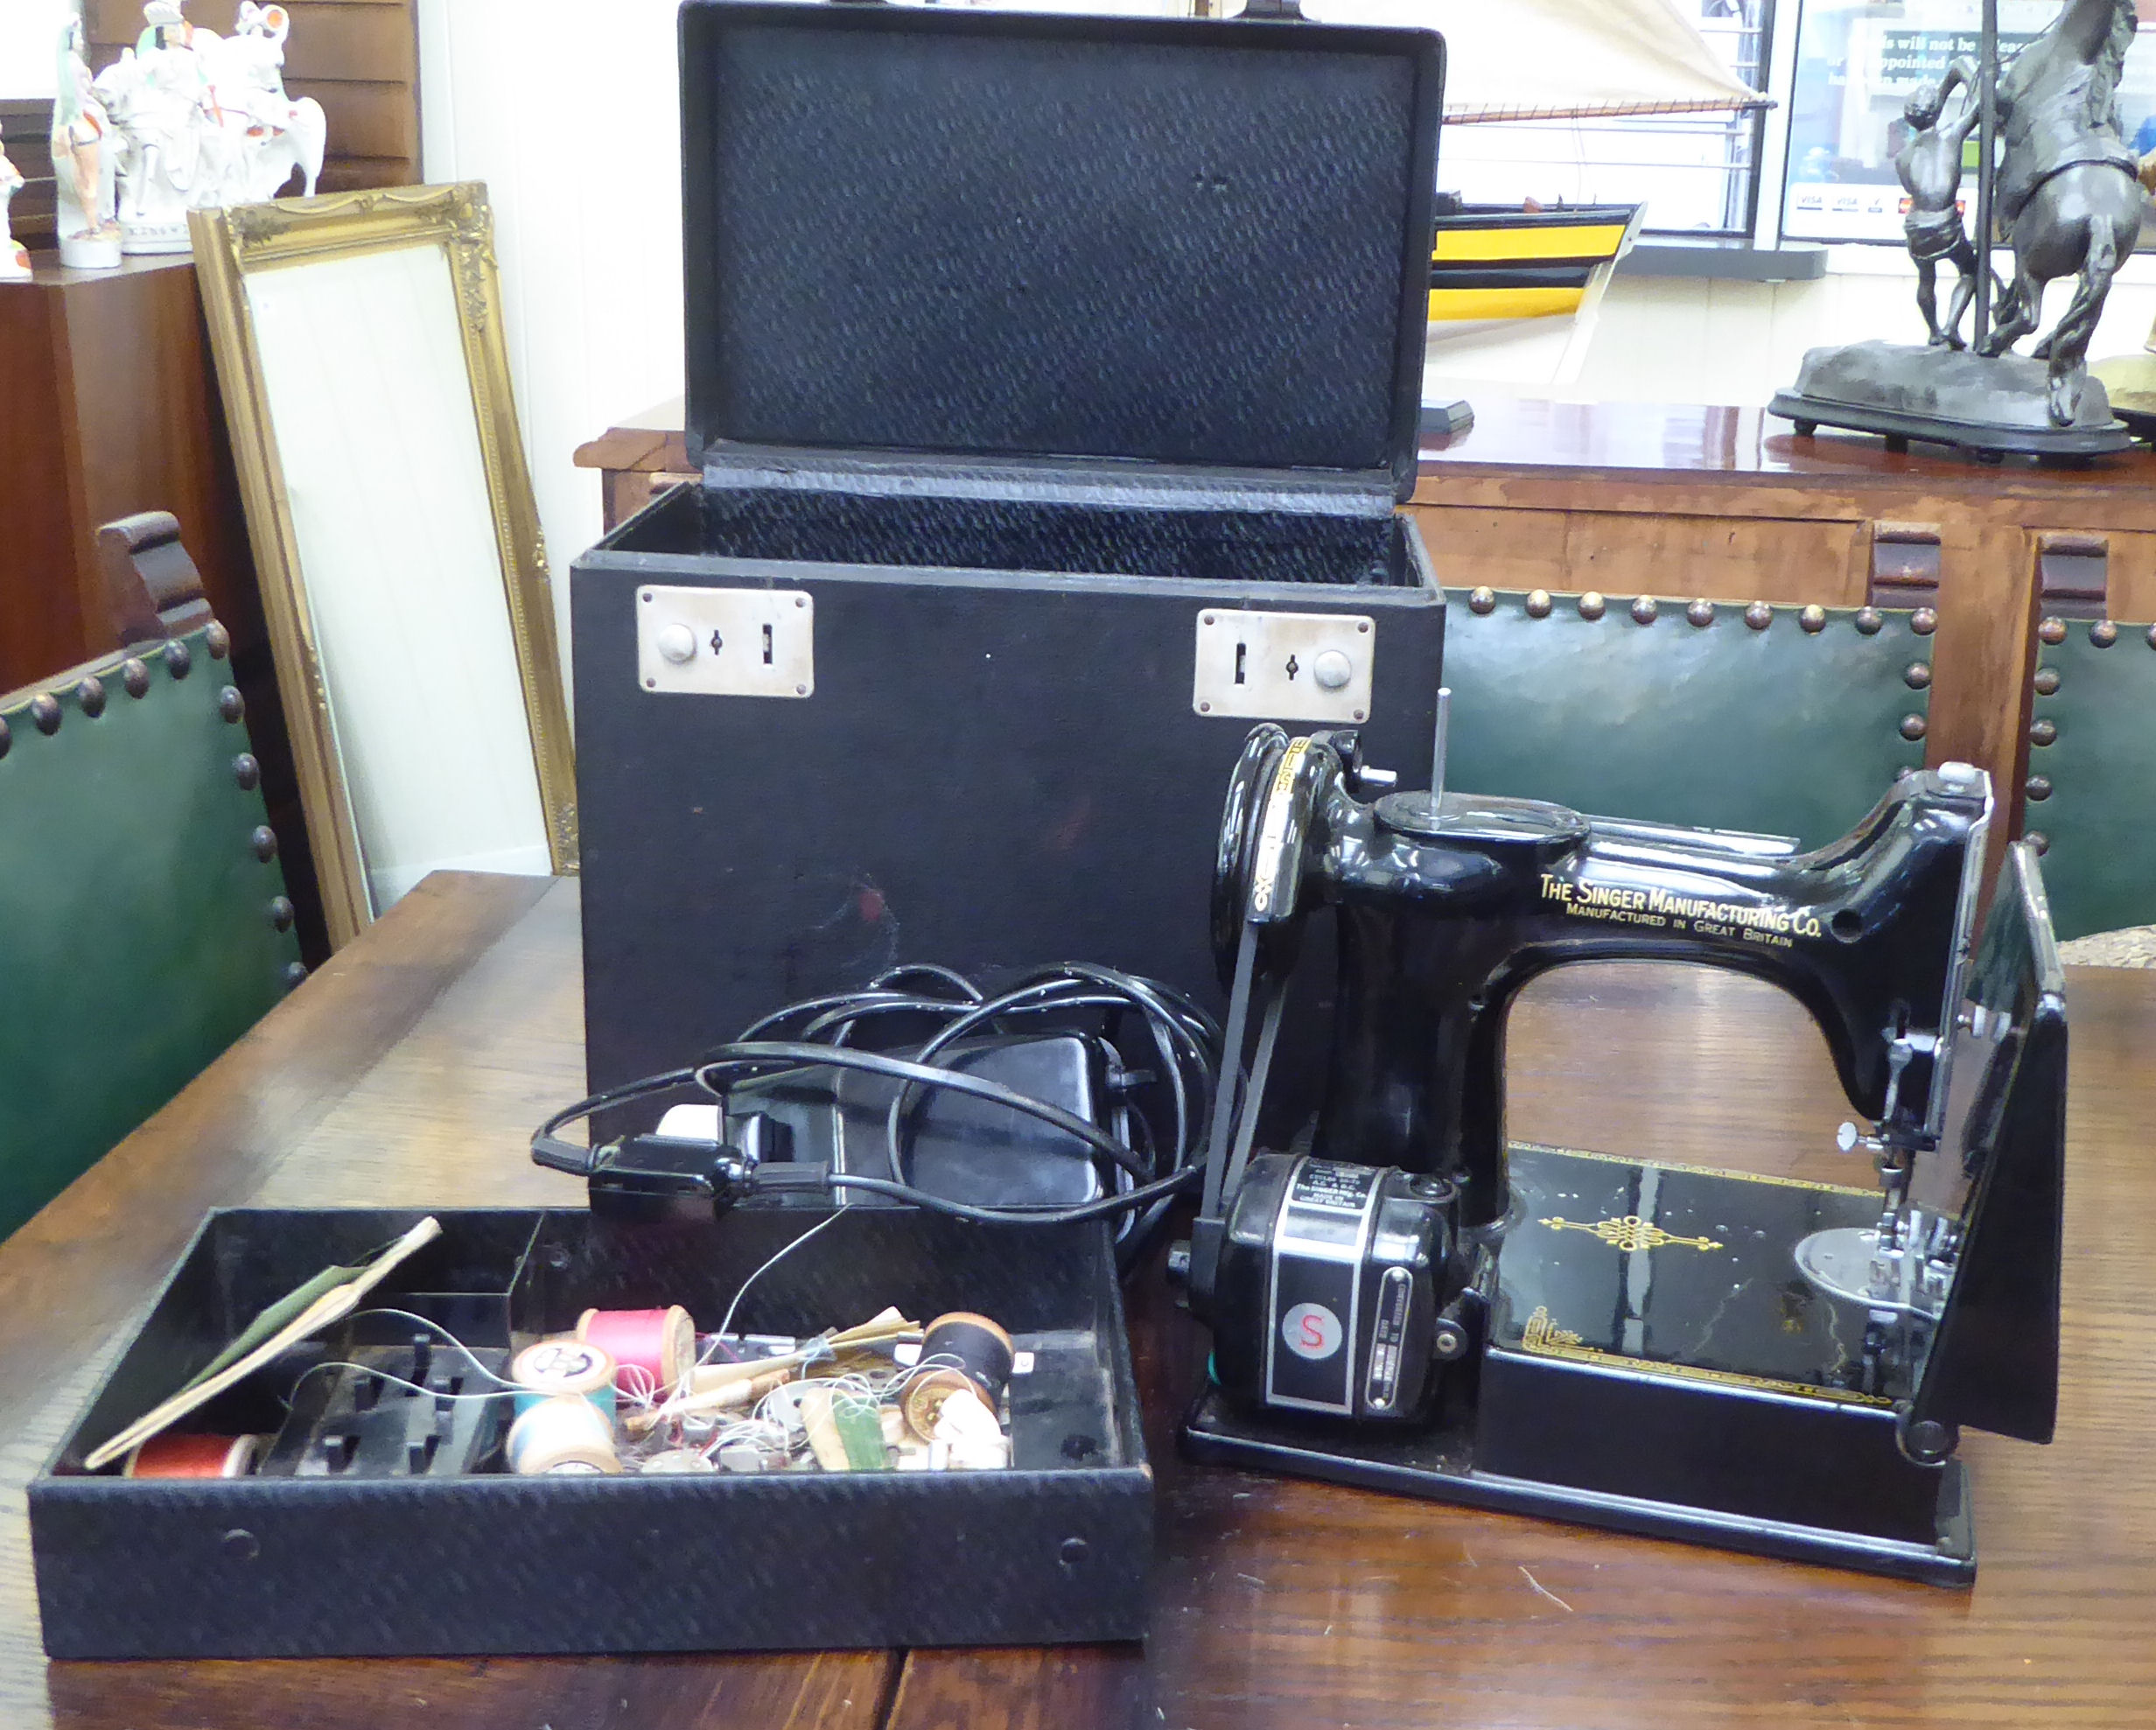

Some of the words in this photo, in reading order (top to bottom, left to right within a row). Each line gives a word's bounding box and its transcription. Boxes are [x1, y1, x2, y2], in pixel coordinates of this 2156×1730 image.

[1897, 36, 1926, 50] will
[1928, 39, 1955, 51] not
[1957, 37, 1976, 52] be
[1880, 54, 1945, 71] ppointed
[1541, 873, 1573, 901] THE
[1577, 877, 1647, 910] SINGER
[1648, 886, 1790, 932] MANUFACTURING
[1566, 902, 1666, 927] MANUFACTURED
[1673, 919, 1686, 929] IN
[1693, 920, 1736, 936] GREAT
[1742, 928, 1793, 949] BRITAIN
[1300, 1313, 1325, 1349] S
